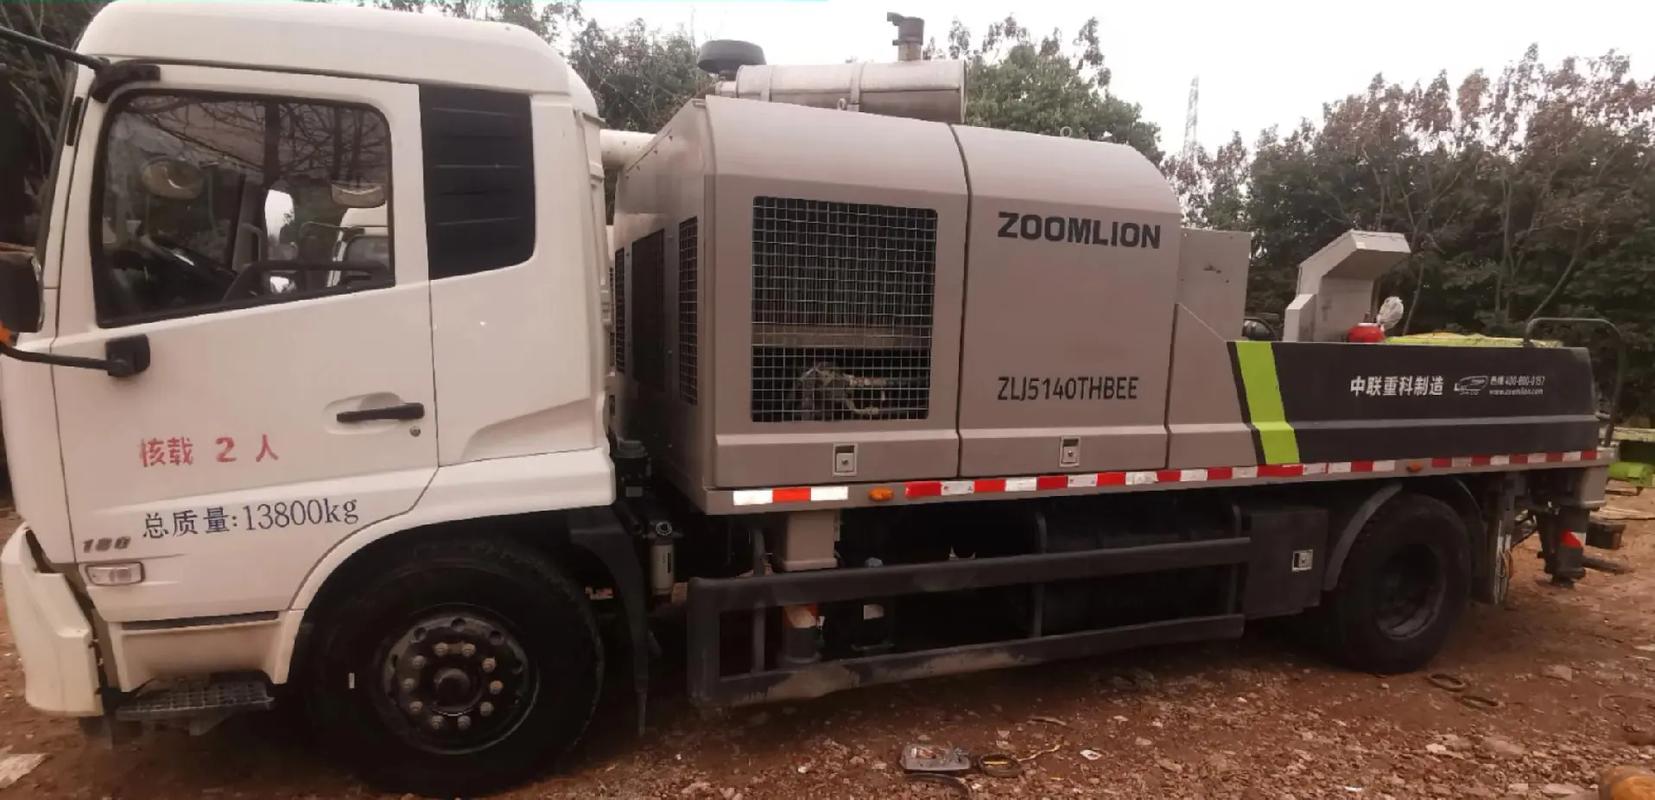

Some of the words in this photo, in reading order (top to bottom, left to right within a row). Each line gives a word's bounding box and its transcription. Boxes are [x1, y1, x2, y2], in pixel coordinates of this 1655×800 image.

[997, 211, 1161, 250] ZOOMLION
[997, 376, 1139, 402] ZLJ5140THBEE
[1350, 375, 1444, 397] 中联重科制造
[140, 435, 194, 467] 核载
[215, 436, 237, 463] 2
[255, 434, 280, 462] 人
